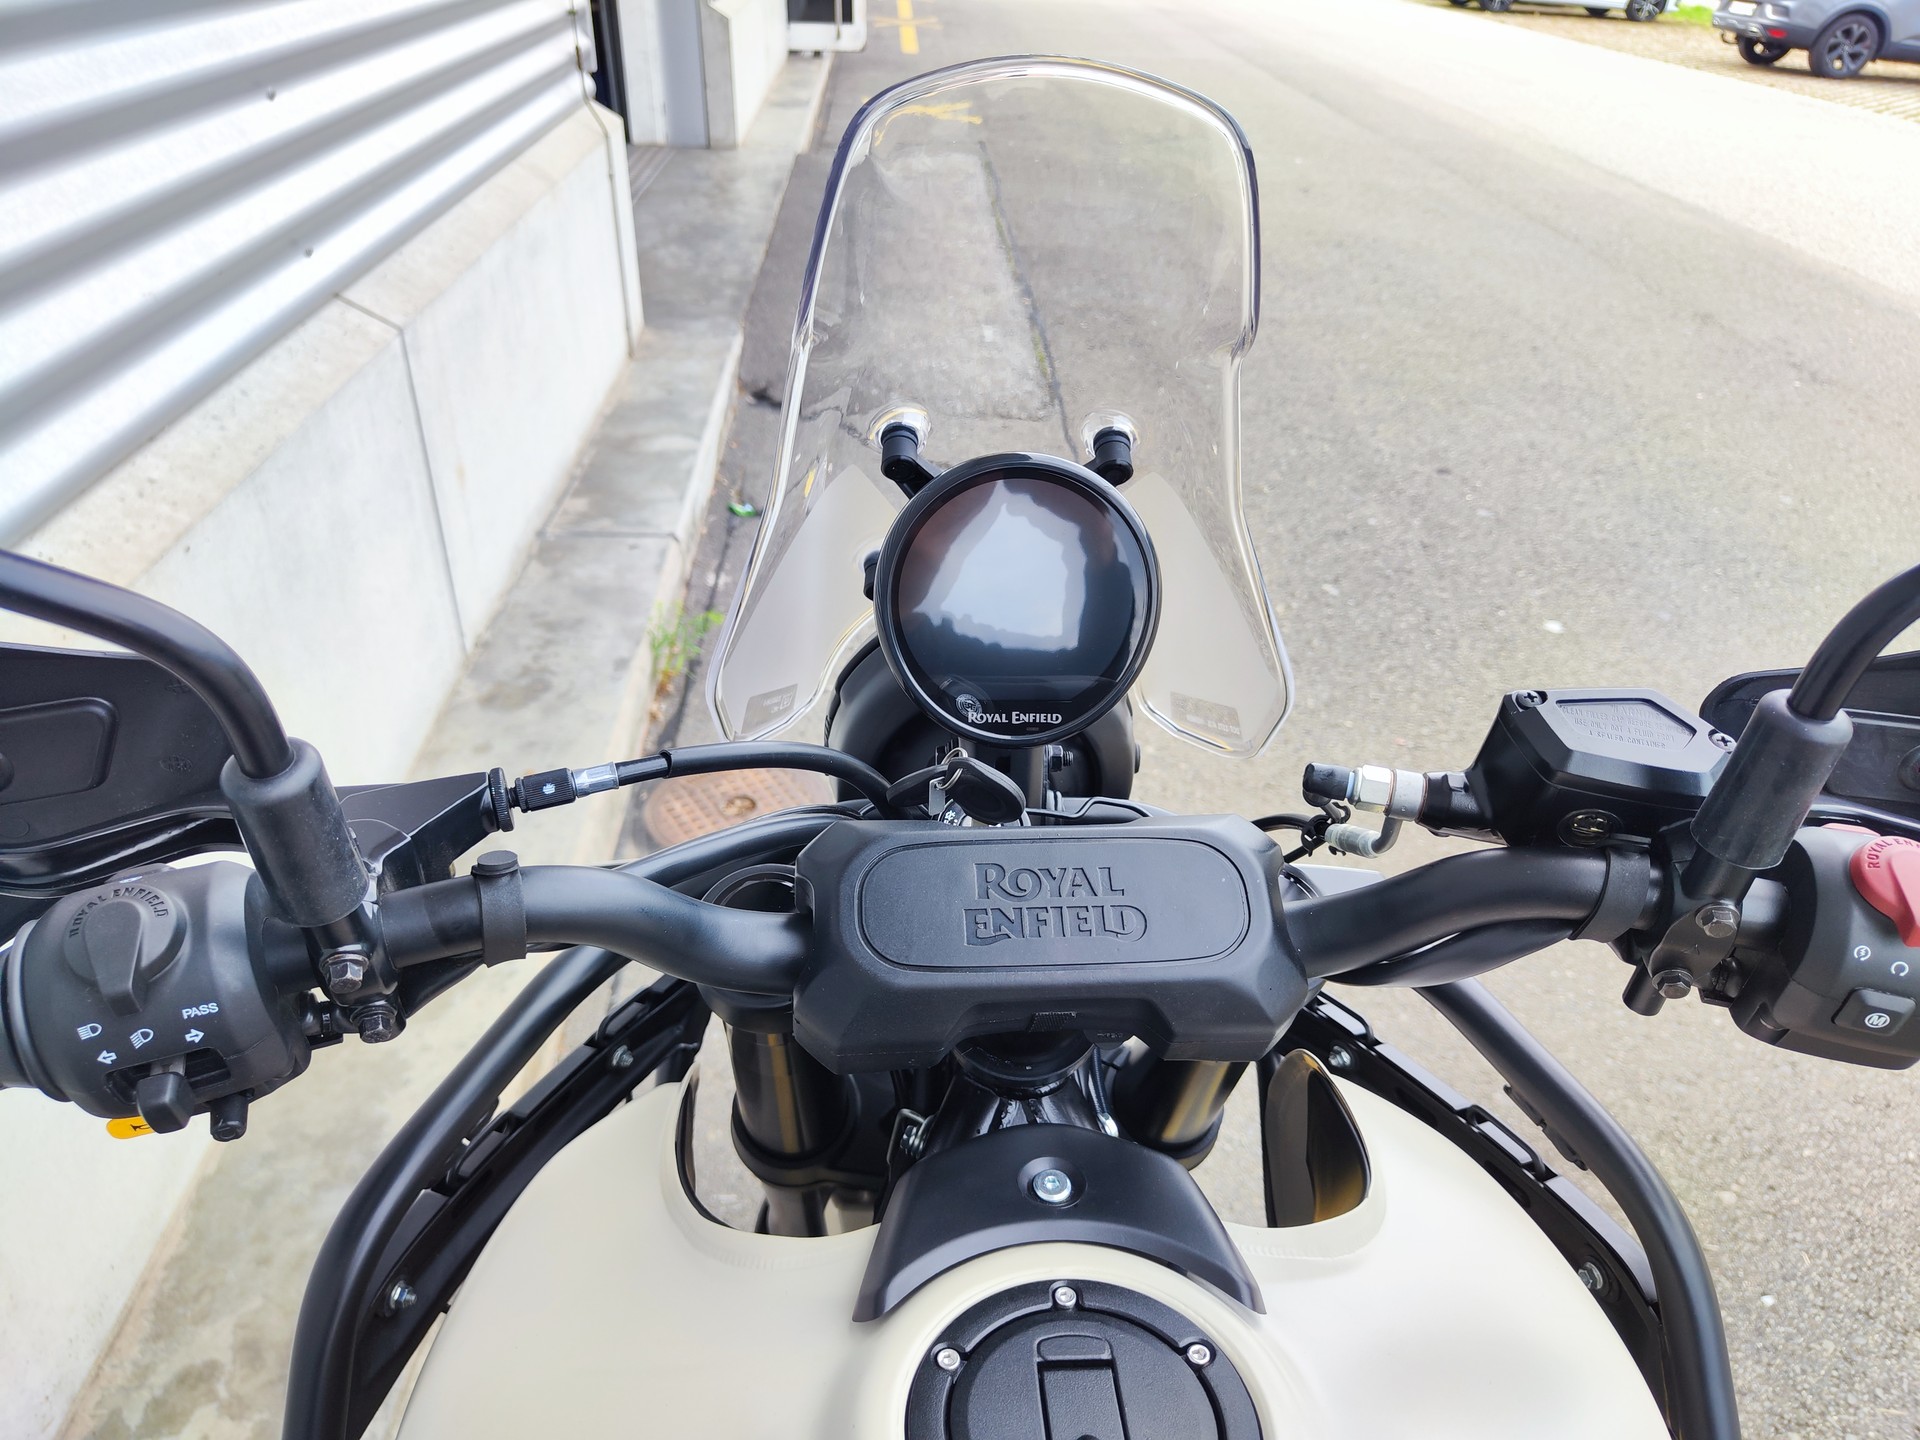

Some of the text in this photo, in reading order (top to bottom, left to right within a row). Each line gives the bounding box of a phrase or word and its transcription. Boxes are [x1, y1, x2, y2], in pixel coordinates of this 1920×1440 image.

[967, 711, 1062, 724] ROYAL ENFIELD
[1866, 839, 1893, 869] ROYAL
[973, 862, 1125, 902] ROYAL
[68, 887, 169, 938] ROYAL ENFIELD
[962, 904, 1148, 946] ENFIELD
[181, 1002, 219, 1019] PASS
